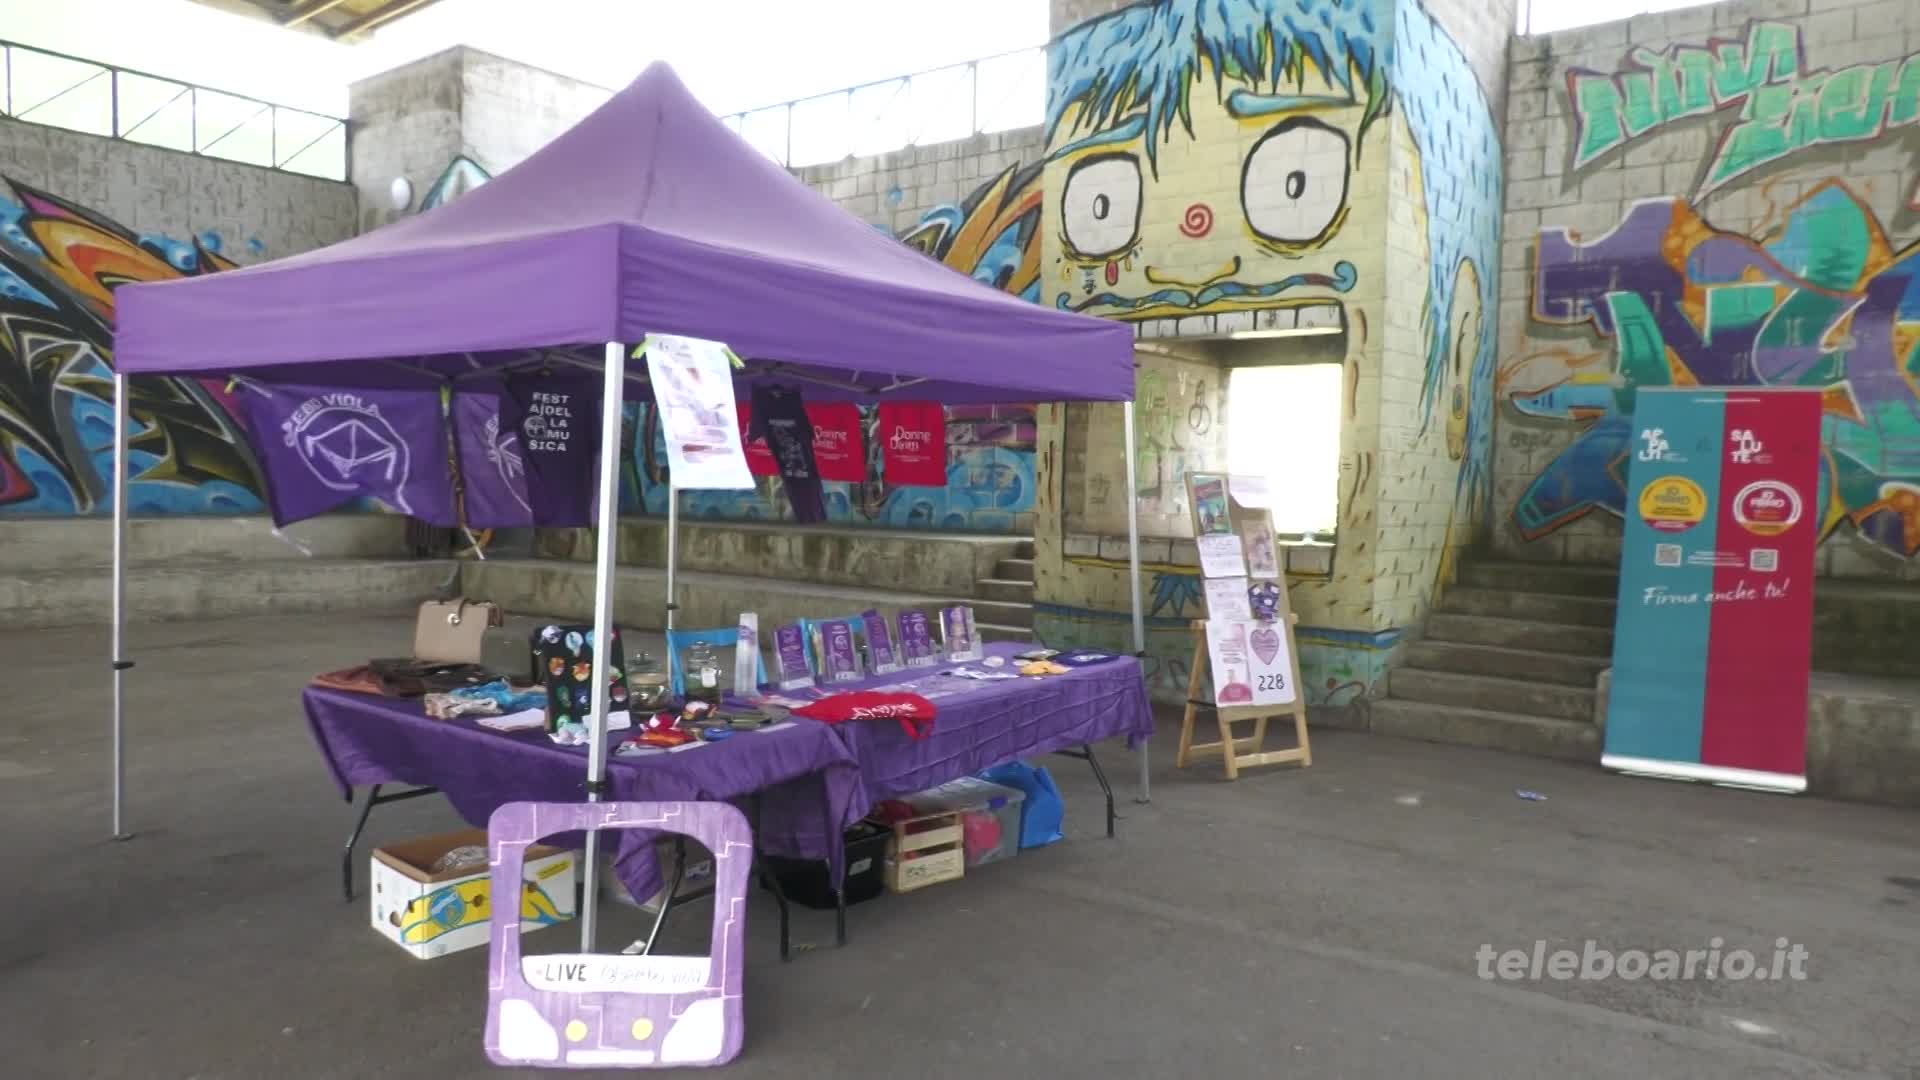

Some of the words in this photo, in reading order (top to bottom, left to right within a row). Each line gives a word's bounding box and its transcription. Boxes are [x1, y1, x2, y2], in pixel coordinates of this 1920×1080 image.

[532, 392, 571, 404] FEST
[550, 418, 568, 428] LA
[1730, 429, 1754, 442] SA
[528, 439, 567, 452] SICA
[1730, 451, 1752, 464] TE
[1643, 585, 1699, 606] Firma
[1704, 579, 1757, 603] anche
[1764, 577, 1791, 599] tu!
[1257, 673, 1285, 692] 228
[544, 963, 587, 982] LIVE
